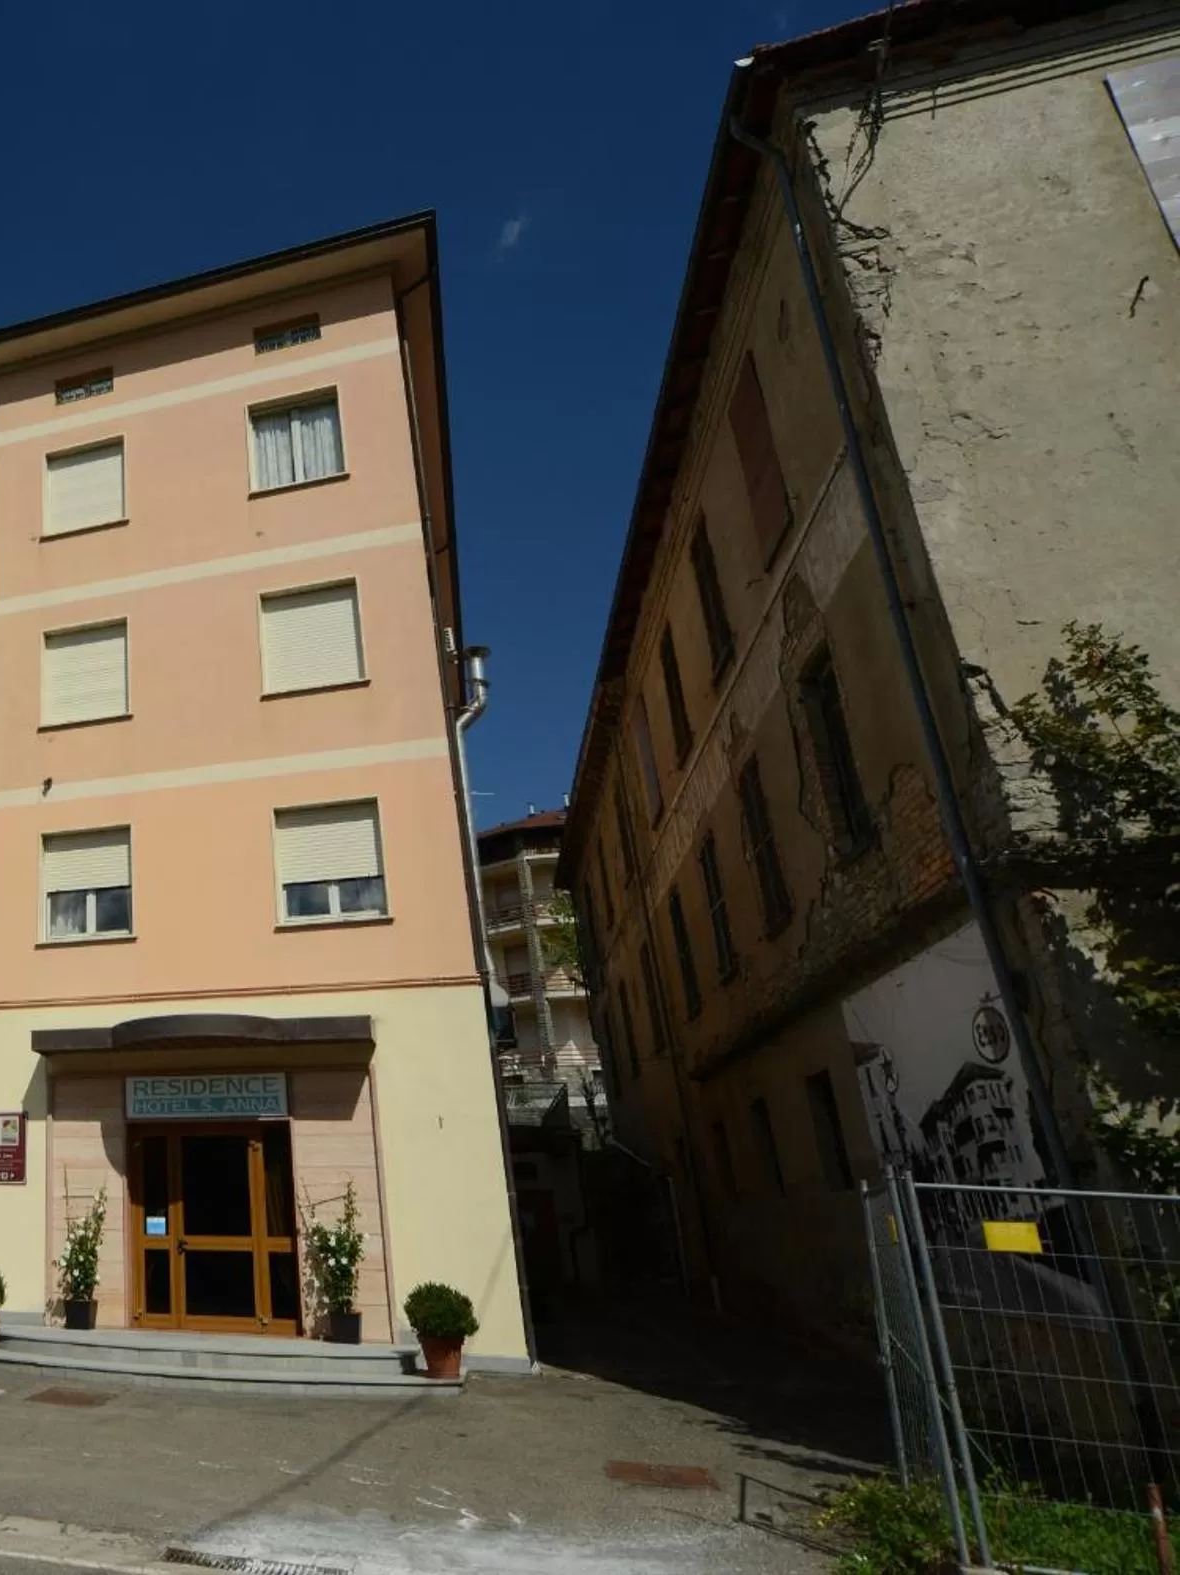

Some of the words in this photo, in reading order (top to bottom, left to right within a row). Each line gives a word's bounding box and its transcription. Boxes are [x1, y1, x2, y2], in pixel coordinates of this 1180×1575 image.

[132, 1076, 281, 1096] RESIDENCE
[134, 1098, 193, 1113] HOTEL
[222, 1096, 280, 1111] ANNA
